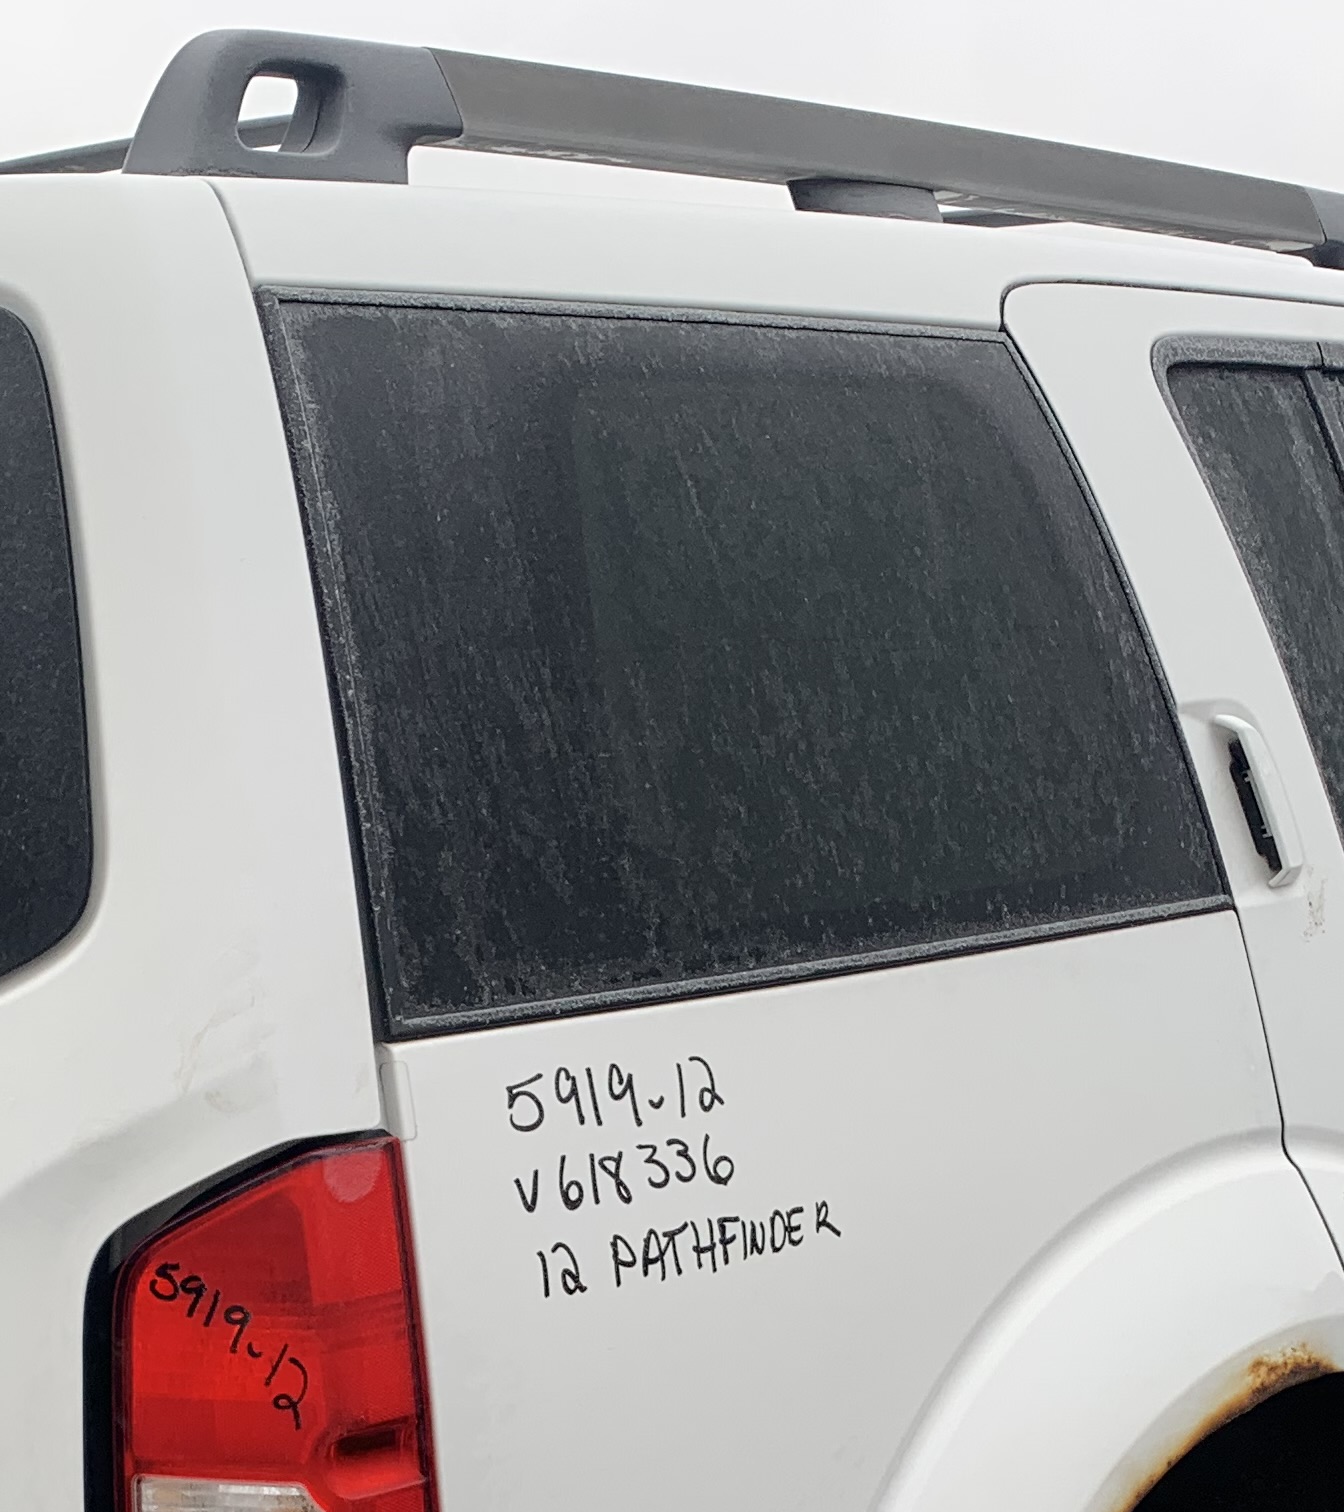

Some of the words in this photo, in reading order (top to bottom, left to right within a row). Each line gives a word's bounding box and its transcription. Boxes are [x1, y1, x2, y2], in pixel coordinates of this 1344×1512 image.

[505, 1055, 725, 1133] 5919-12
[537, 1242, 587, 1298] 12
[609, 1200, 842, 1288] PATHFINDER
[149, 1262, 309, 1431] 5919-12
